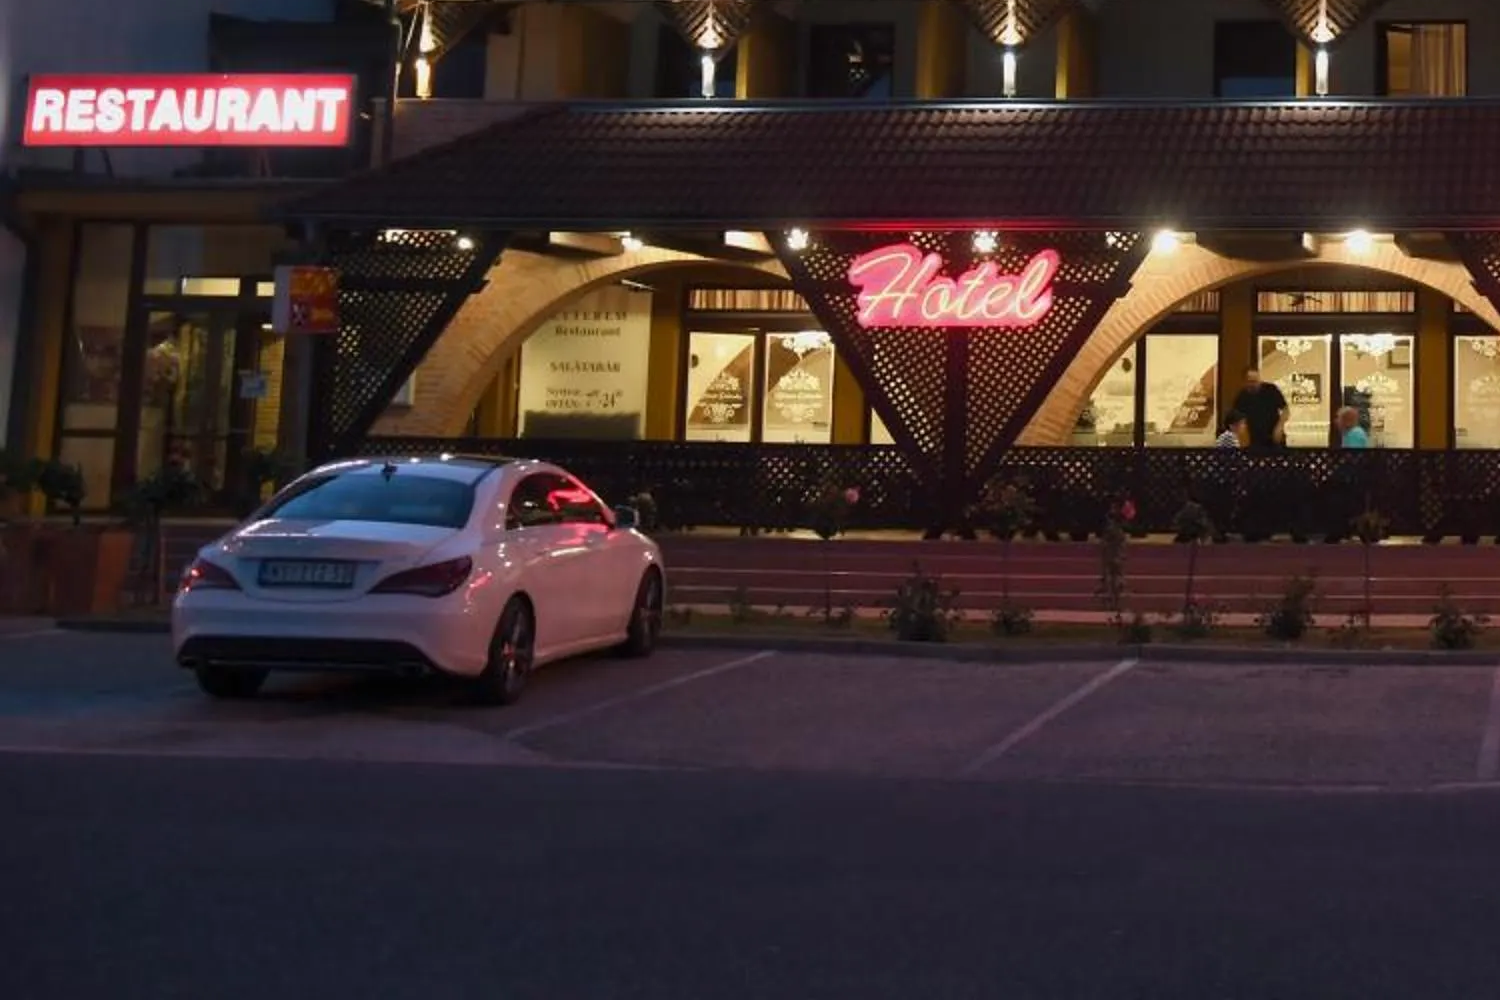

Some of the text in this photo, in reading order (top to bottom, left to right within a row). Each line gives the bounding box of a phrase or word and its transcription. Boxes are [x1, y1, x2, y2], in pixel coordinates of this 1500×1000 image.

[31, 87, 347, 133] RESTAURANT
[847, 242, 1060, 327] Hotel
[555, 325, 621, 336] Restaurant
